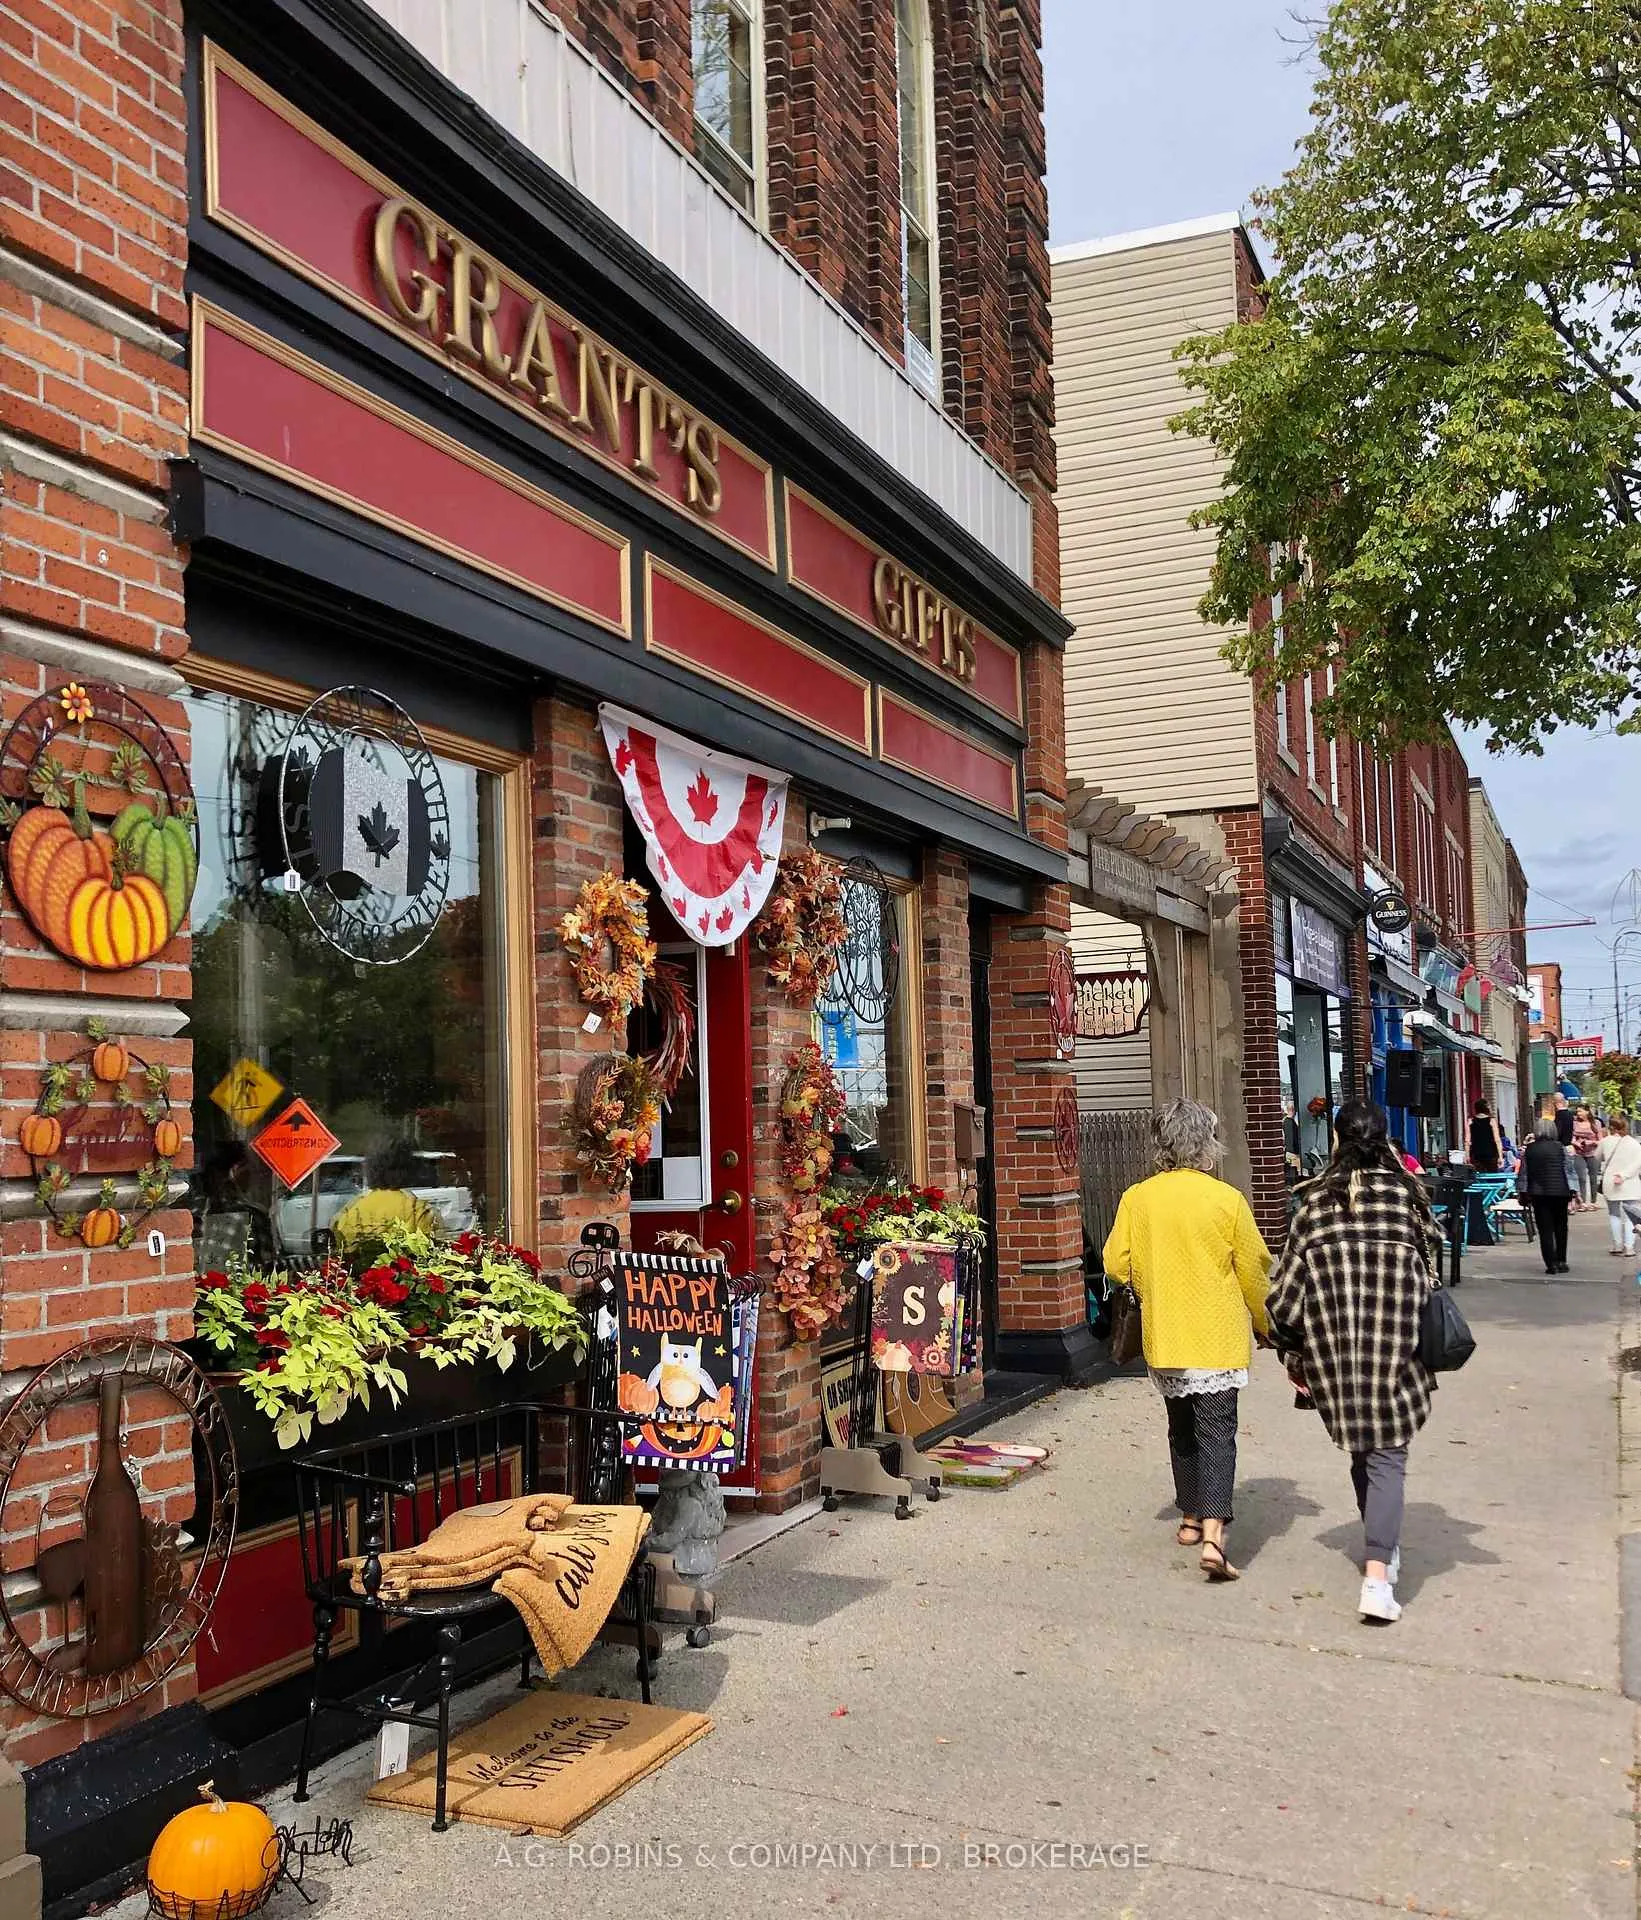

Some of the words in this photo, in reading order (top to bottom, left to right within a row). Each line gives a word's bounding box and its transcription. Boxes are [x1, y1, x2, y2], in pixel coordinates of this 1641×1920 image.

[374, 197, 722, 515] GRANT'S
[874, 558, 977, 685] GIFTS
[1375, 910, 1407, 919] GUINNESS
[624, 1269, 718, 1311] HAPPY
[627, 1306, 723, 1337] HALLOWEEN
[902, 1285, 926, 1326] S
[547, 1543, 596, 1610] cute
[467, 1742, 538, 1781] Welcome
[535, 1729, 554, 1742] to
[551, 1716, 579, 1731] the
[498, 1717, 631, 1790] SHITSHOW
